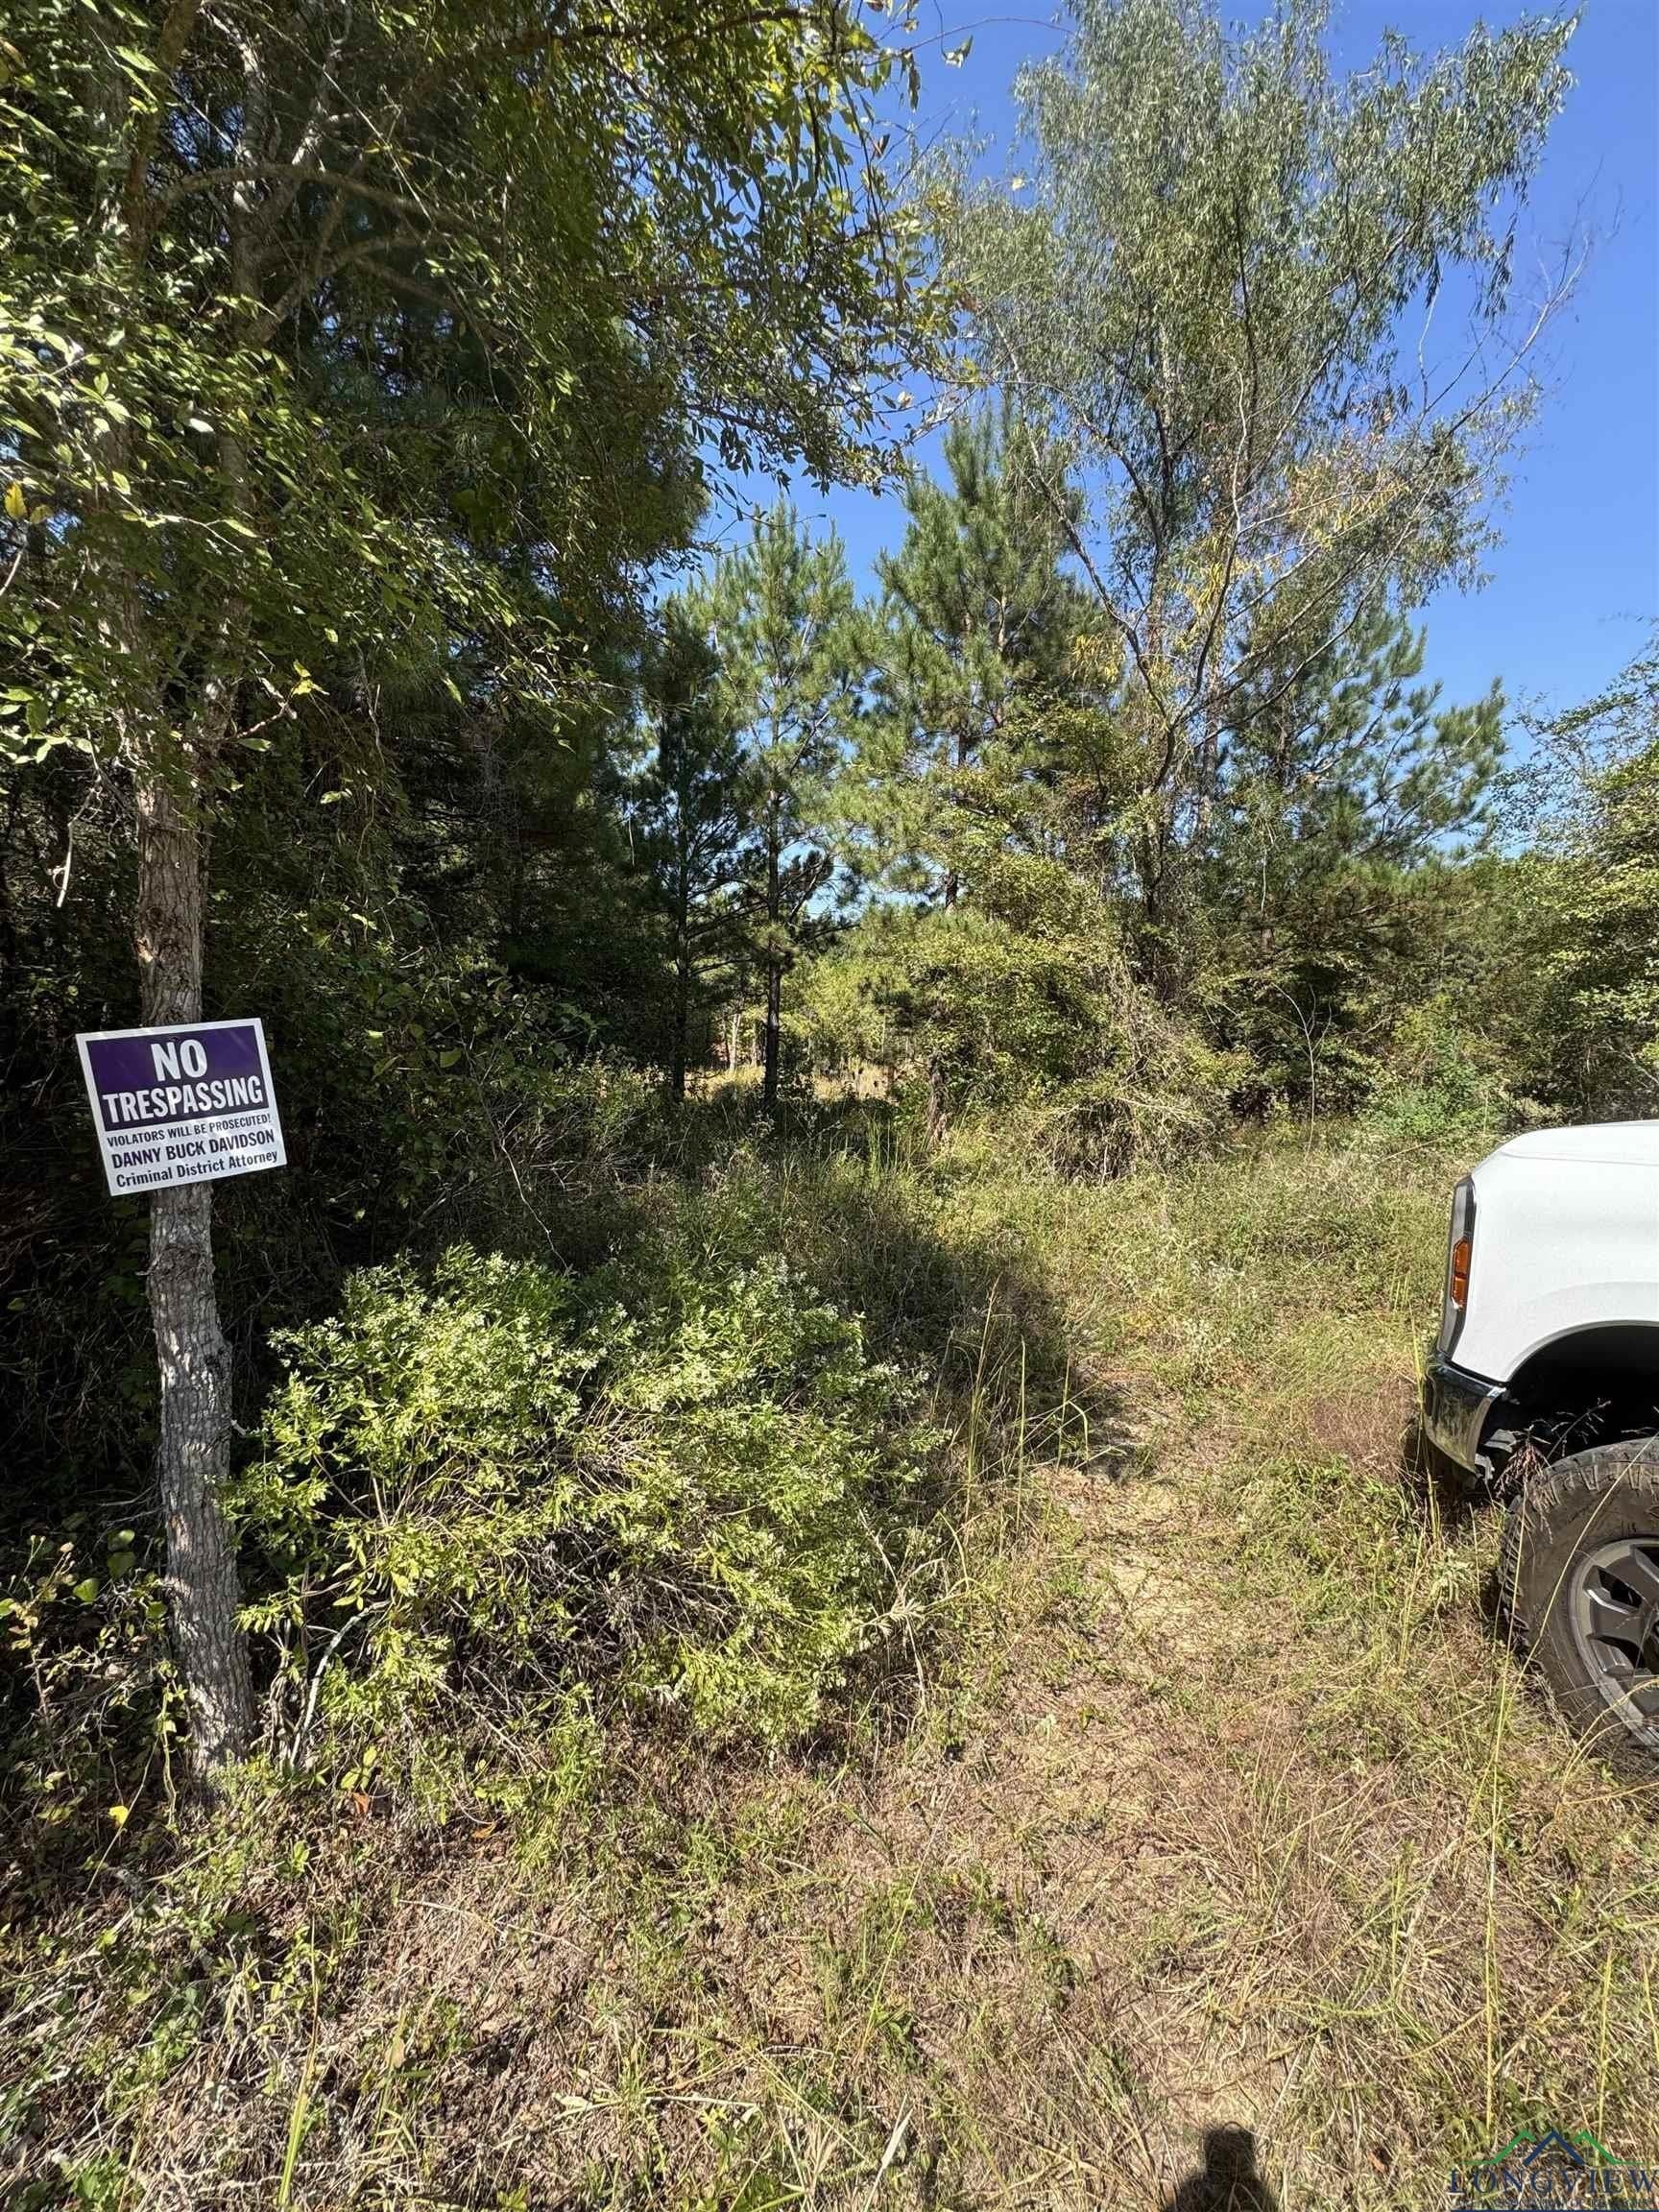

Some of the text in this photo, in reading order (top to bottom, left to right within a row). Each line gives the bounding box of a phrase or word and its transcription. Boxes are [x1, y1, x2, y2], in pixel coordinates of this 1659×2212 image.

[152, 1040, 207, 1081] NO
[103, 1075, 263, 1123] TRESPASSING
[108, 1114, 271, 1146] VIOLATORS WILL BE PROSECUTED!
[111, 1129, 275, 1168] DANNY BUCK DAVIDSON
[116, 1151, 277, 1187] Criminal District Attorney
